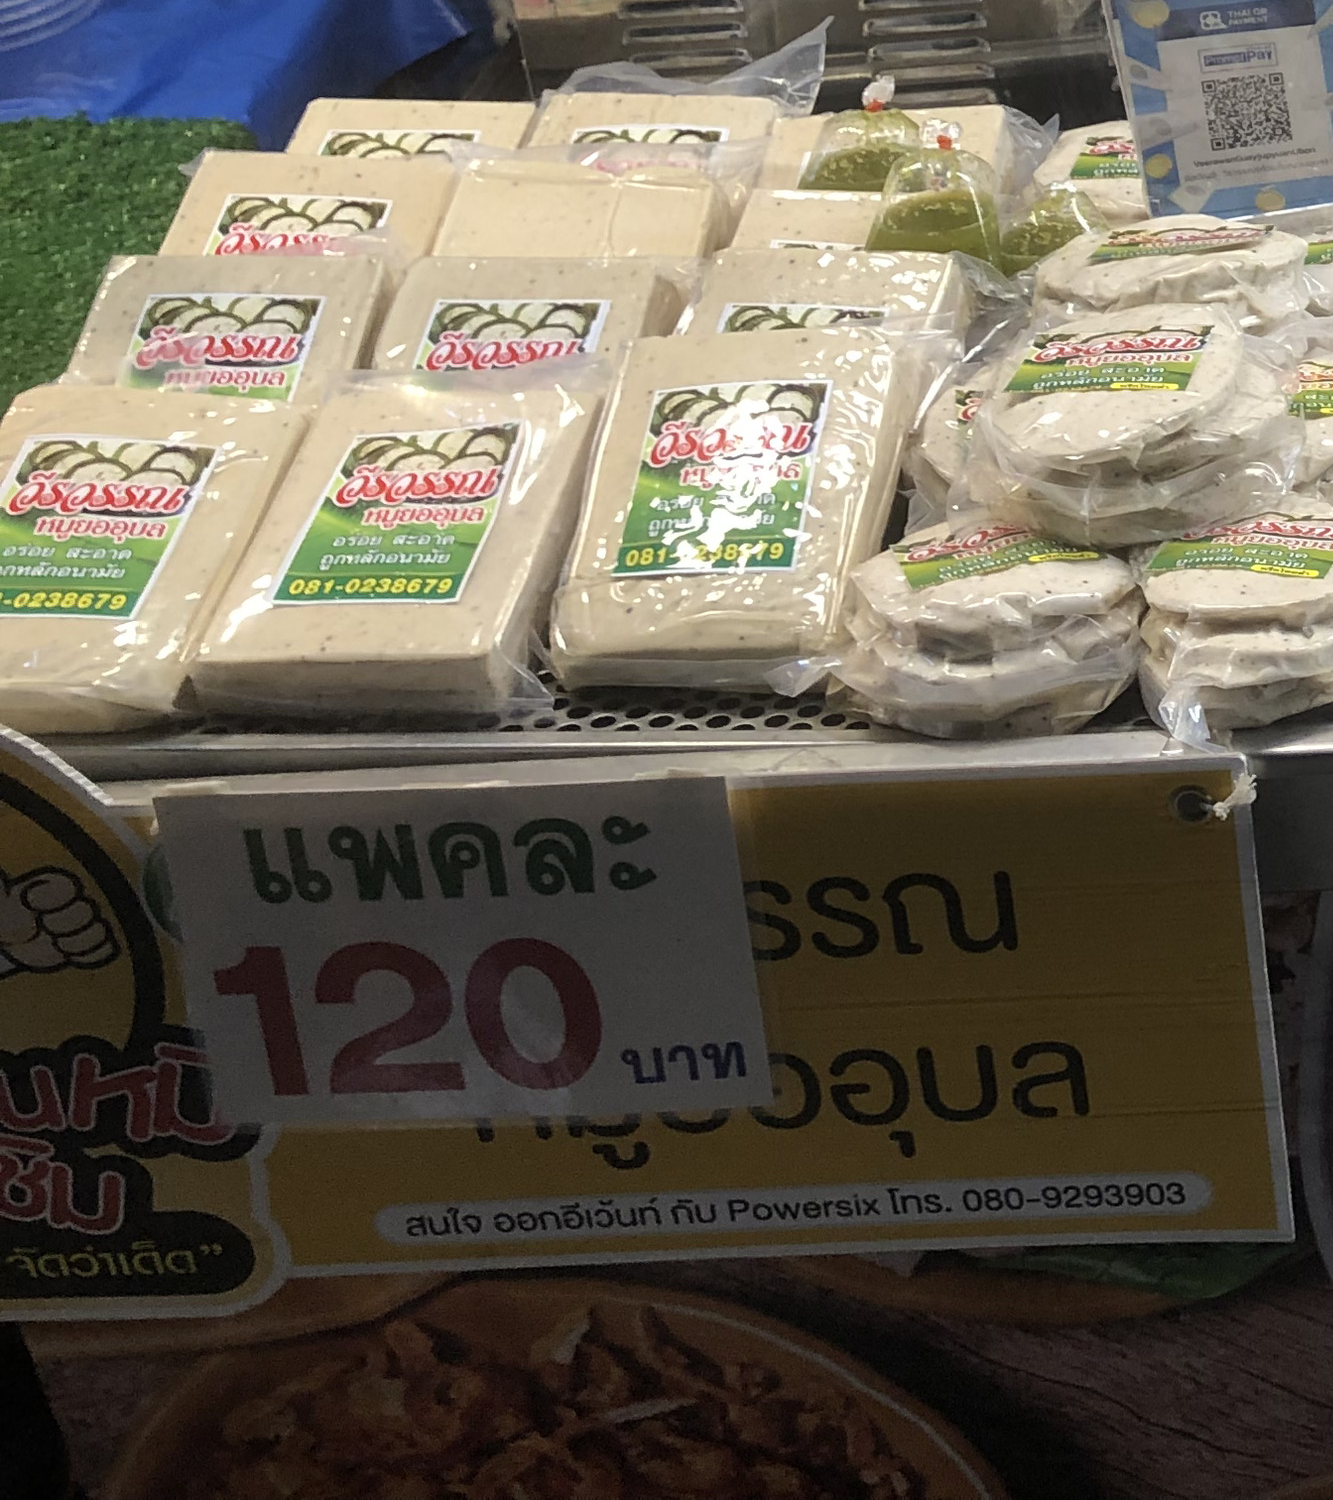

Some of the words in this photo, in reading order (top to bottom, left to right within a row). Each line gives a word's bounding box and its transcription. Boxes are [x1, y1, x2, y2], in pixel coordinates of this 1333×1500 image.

[8, 470, 189, 515] วีรวรรณ
[335, 464, 500, 507] วีรวรรณ
[35, 516, 167, 543] หมูยออุบล
[362, 505, 486, 529] หมูยออุบล
[289, 577, 454, 595] 081-0238679
[242, 813, 657, 904] แพคละ
[213, 937, 603, 1097] 120
[622, 1040, 748, 1085] บาท
[406, 1207, 482, 1238] สนใจ
[671, 1198, 717, 1225] กับ
[729, 1193, 881, 1223] Powersix
[887, 1187, 951, 1217] โทร.
[962, 1181, 1187, 1212] 080-9293903
